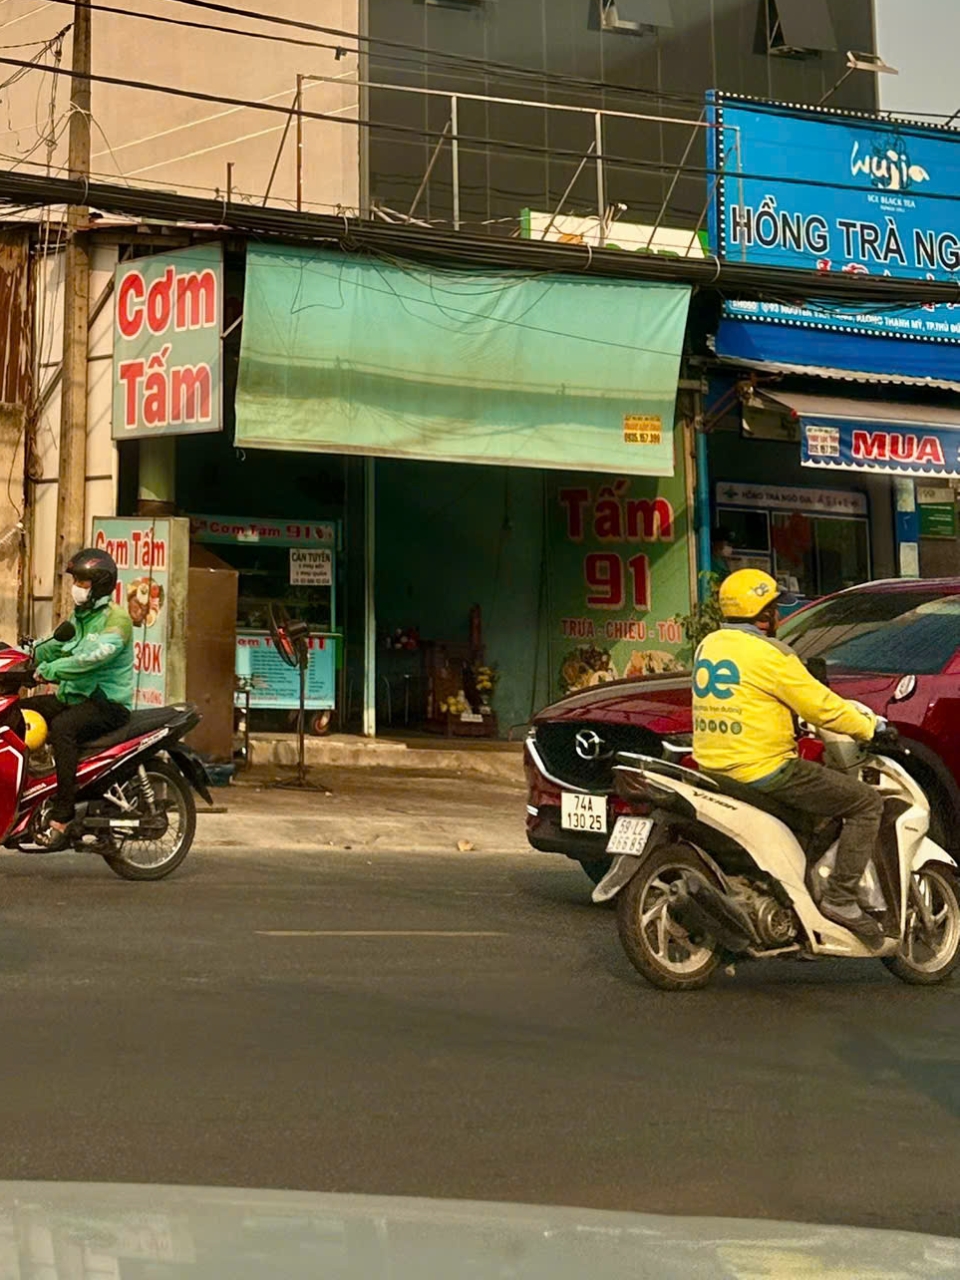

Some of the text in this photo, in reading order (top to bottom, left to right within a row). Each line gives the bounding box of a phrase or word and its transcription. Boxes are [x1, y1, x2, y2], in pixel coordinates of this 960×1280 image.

[729, 195, 829, 255] HỒNG
[836, 217, 907, 266] TRÀ
[117, 265, 217, 341] Cơm
[118, 344, 212, 430] Tấm
[852, 430, 945, 465] MUA
[560, 478, 675, 543] Tấm
[131, 525, 166, 571] Tấm
[584, 551, 651, 611] 91
[561, 617, 595, 638] TRƯA
[605, 612, 646, 641] CHIỀU
[133, 641, 163, 673] 30K
[693, 645, 740, 700] be
[573, 795, 594, 812] 74A
